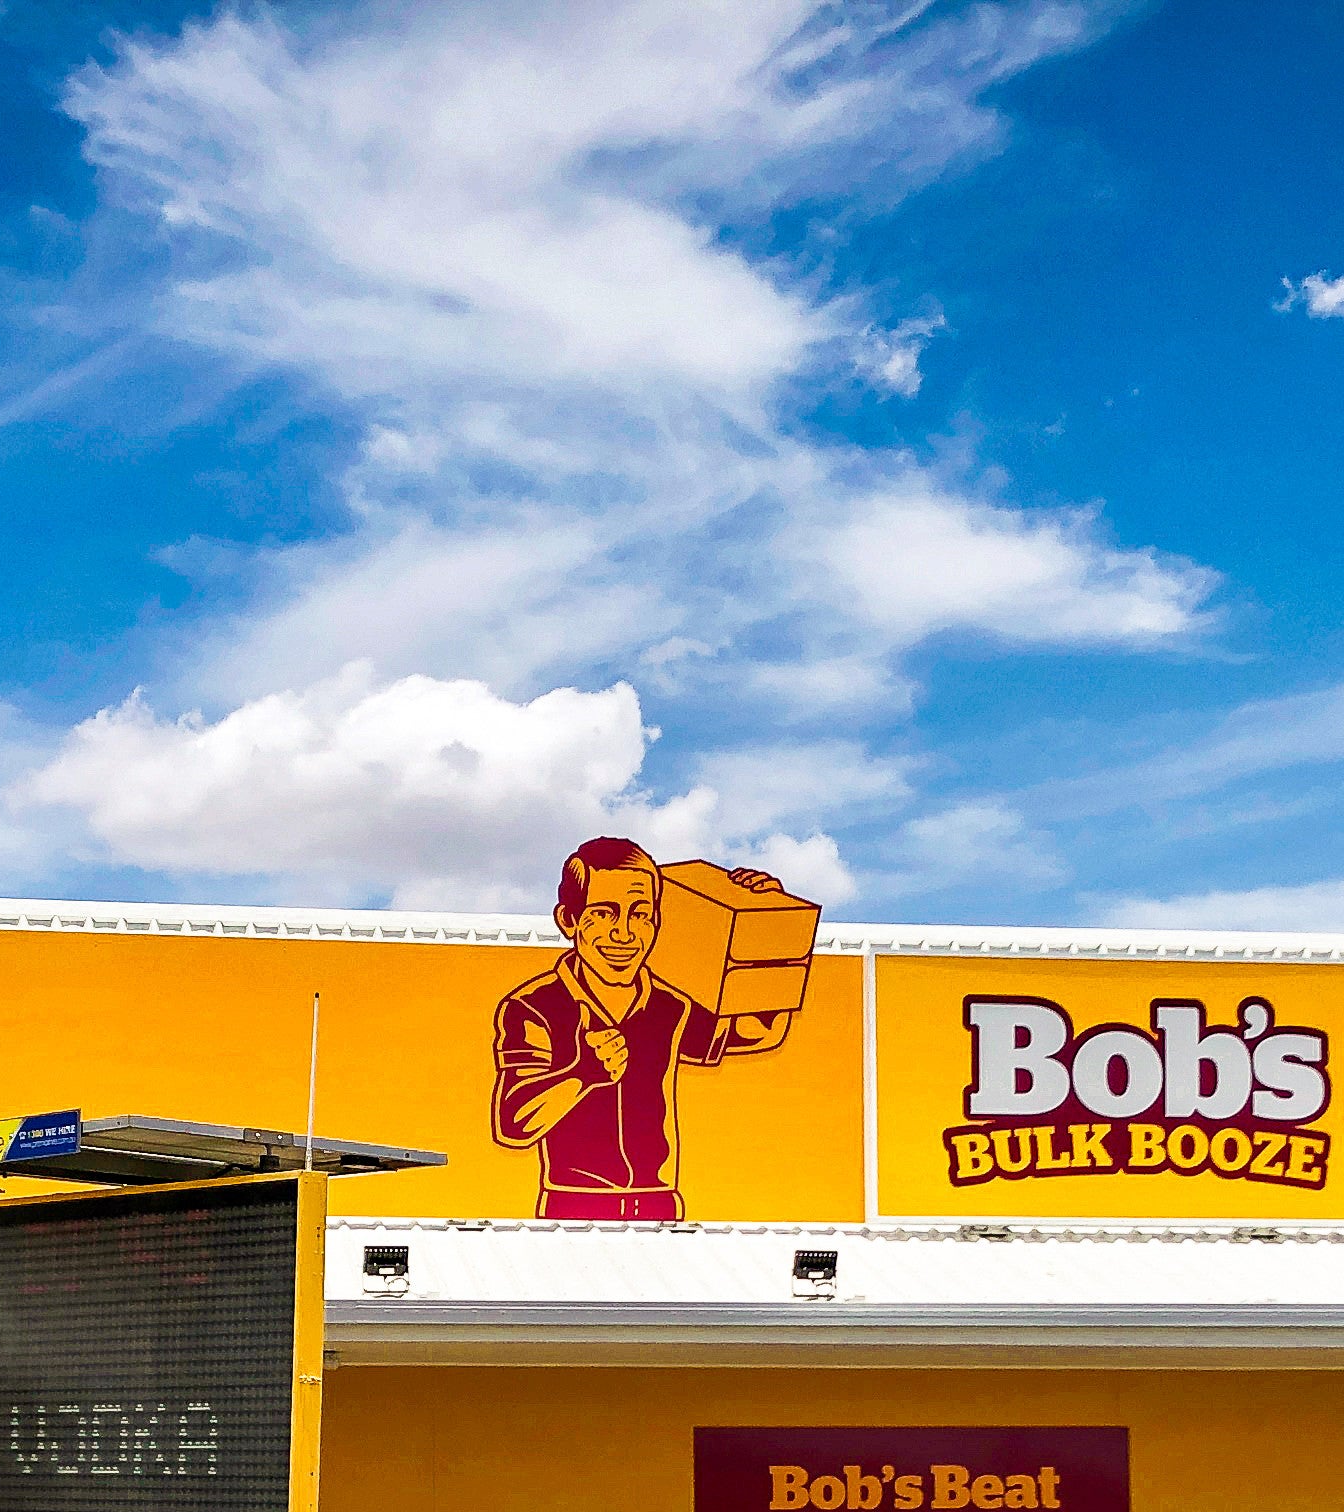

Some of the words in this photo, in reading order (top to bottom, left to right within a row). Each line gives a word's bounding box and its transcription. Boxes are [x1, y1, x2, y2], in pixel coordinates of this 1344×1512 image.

[969, 1001, 1323, 1121] Bob's
[950, 1122, 1113, 1179] BULK
[1127, 1122, 1329, 1183] BOOZE
[769, 1465, 924, 1510] Bob's
[930, 1464, 1061, 1510] Beat
